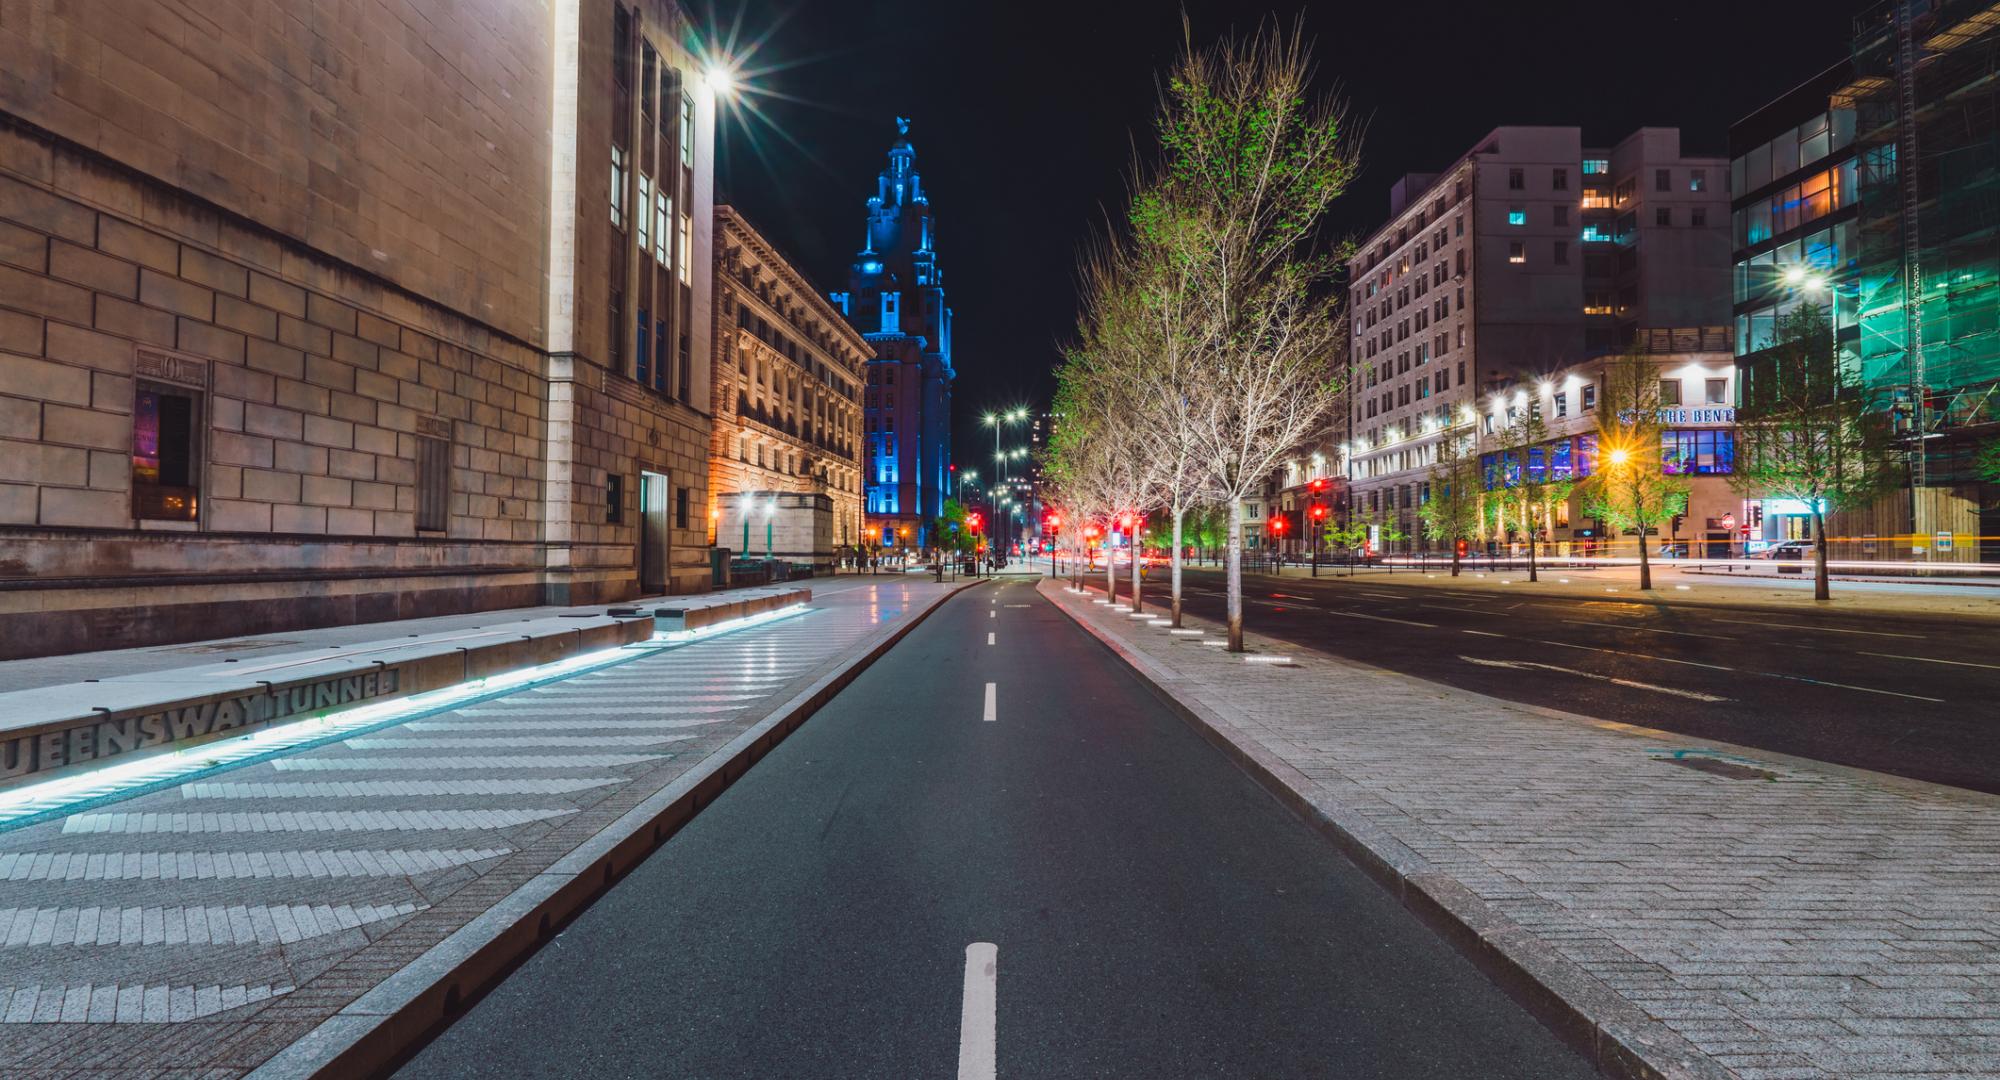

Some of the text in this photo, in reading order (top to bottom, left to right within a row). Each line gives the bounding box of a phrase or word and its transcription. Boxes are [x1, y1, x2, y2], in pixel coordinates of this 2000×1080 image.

[1656, 408, 1687, 423] THE
[1691, 407, 1735, 423] BENT
[274, 670, 397, 717] TUNNEL
